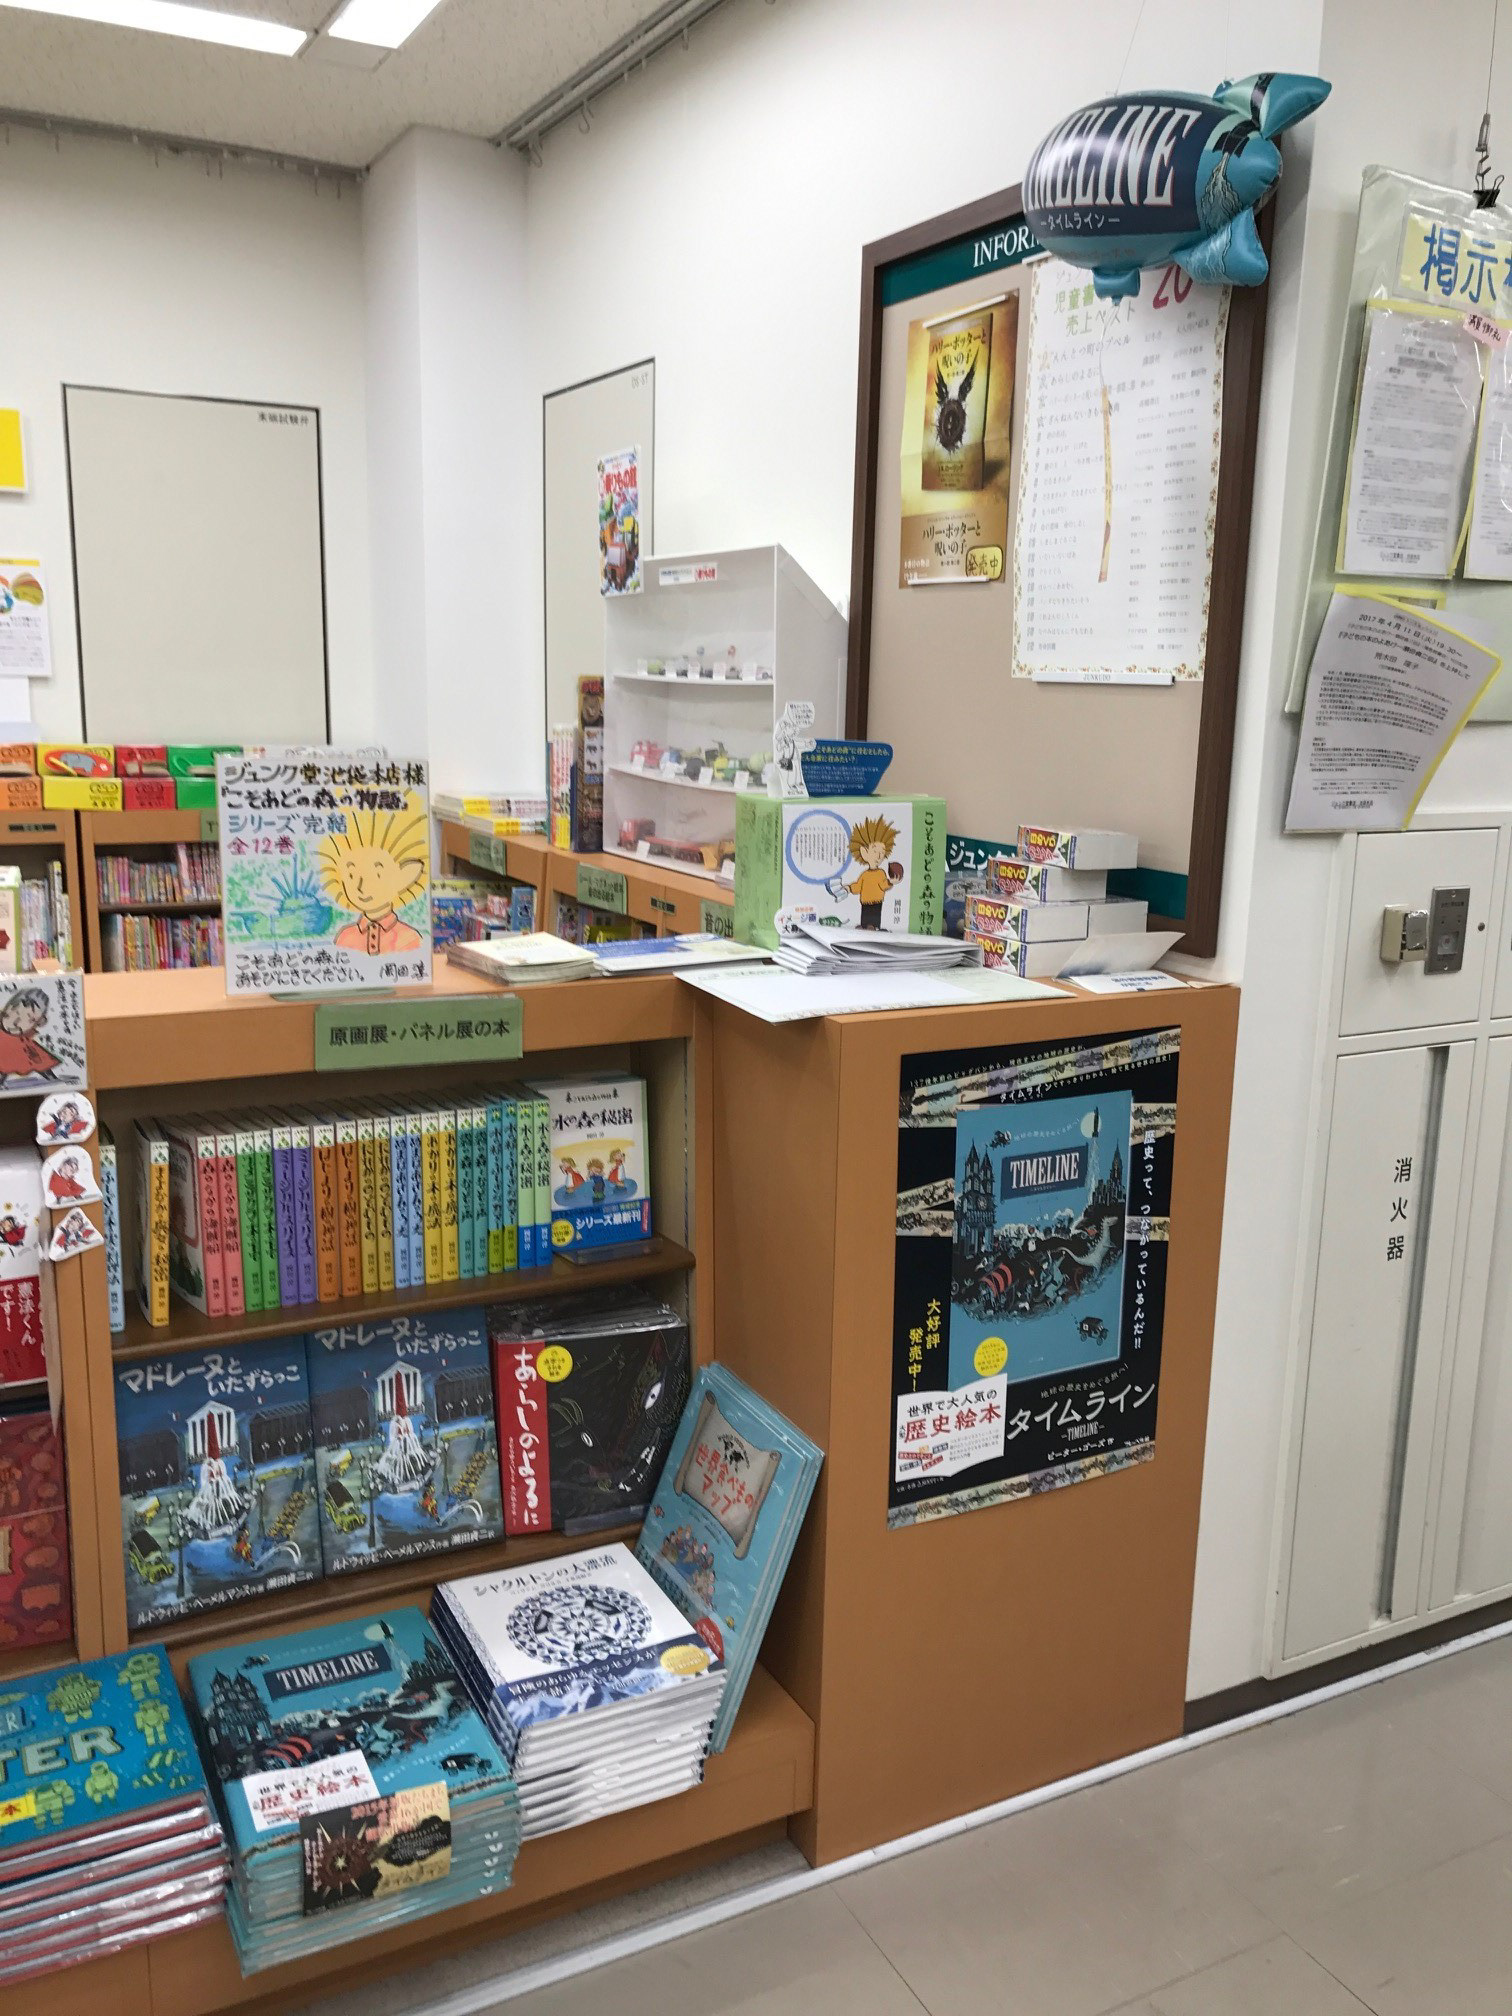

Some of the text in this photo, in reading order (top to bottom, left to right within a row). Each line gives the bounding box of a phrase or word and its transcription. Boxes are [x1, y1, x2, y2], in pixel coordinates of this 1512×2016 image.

[329, 1018, 510, 1046] 原画展・パネル展の本
[1009, 1152, 1080, 1191] TIMELINE
[1387, 1157, 1412, 1261] 消火器
[315, 1317, 427, 1351] マドレーヌと
[396, 1330, 482, 1357] いたずらっこ
[926, 1299, 941, 1350] 大好評
[119, 1353, 242, 1394] マドレーヌと
[207, 1364, 301, 1397] いたずらっこ
[904, 1403, 1001, 1444] 歴史絵本
[907, 1388, 998, 1418] 世界で大人気の
[1006, 1383, 1156, 1440] タイムライン
[513, 1346, 540, 1527] あらしのよるに
[473, 1552, 618, 1597] シャクルトンの大漂流
[276, 1648, 380, 1692] TIMELINE
[260, 1773, 369, 1812] 歴史絵本
